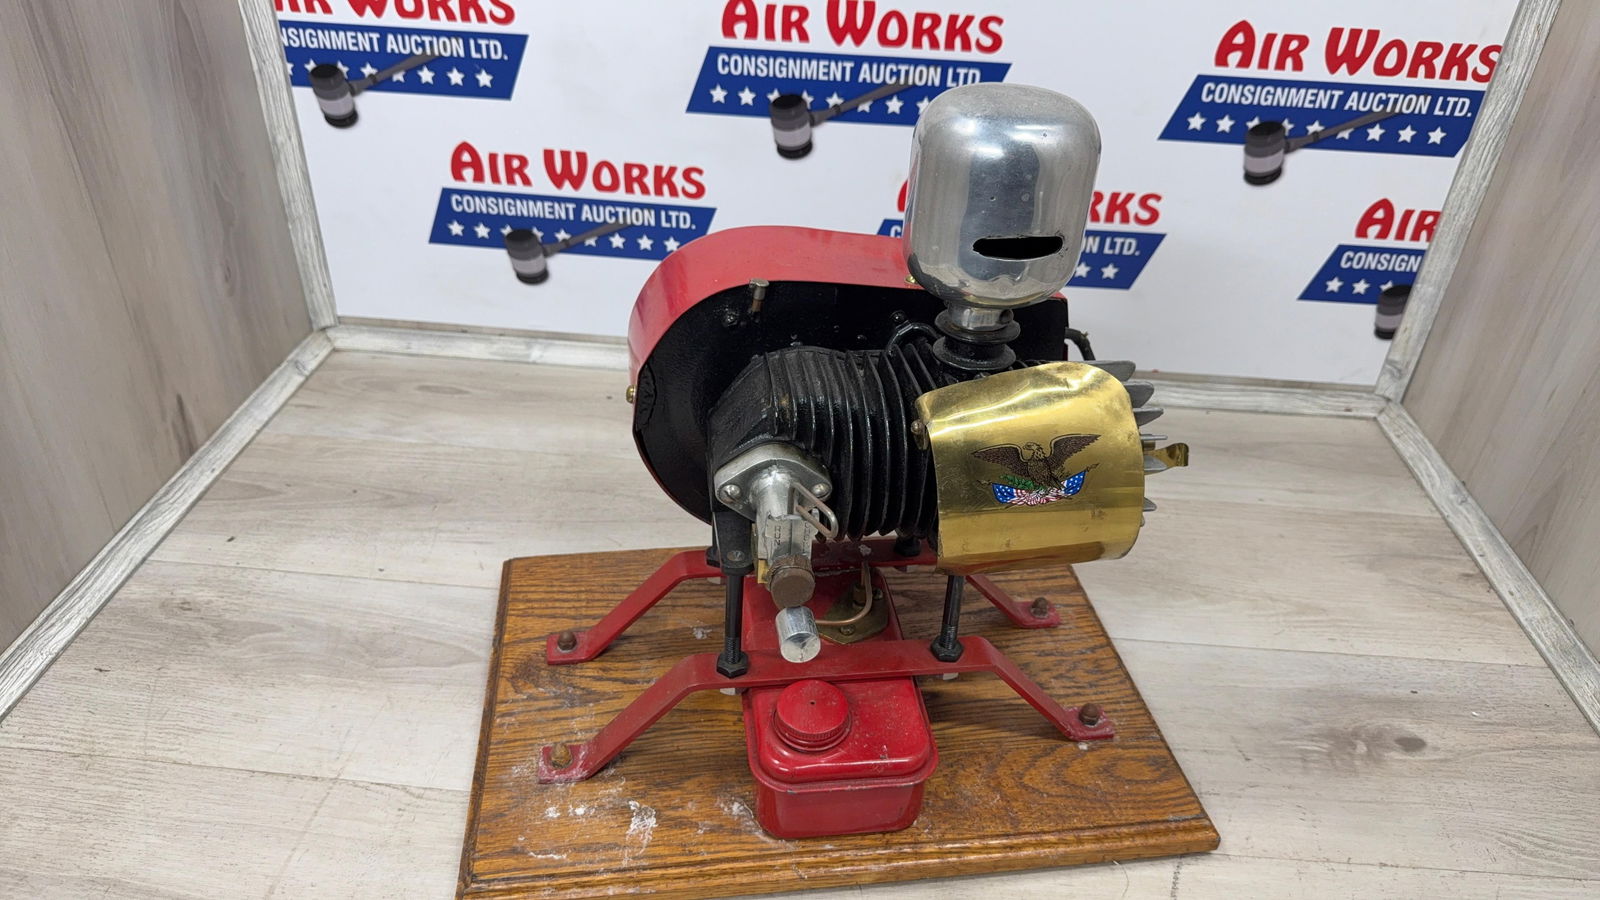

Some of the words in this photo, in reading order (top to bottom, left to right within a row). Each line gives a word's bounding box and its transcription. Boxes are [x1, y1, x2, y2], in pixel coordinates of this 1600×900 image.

[281, 27, 380, 52] NSIGNMENT
[386, 34, 464, 57] AUCTION
[469, 39, 508, 60] LTD.
[721, 0, 810, 43] AIR
[826, 0, 1004, 54] WORKS
[1214, 20, 1310, 72] AIR
[1325, 27, 1503, 83] WORKS
[717, 54, 854, 82] CONSIGNMENT
[858, 62, 942, 87] AUCTION
[946, 67, 981, 88] LTD
[1201, 82, 1344, 110] CONSIGNMENT
[1344, 91, 1431, 115] AUCTION
[1434, 96, 1472, 117] LTD.
[450, 141, 532, 187] AIR
[543, 148, 706, 200] WORKS
[452, 194, 577, 221] CONSIGNMENT
[581, 204, 656, 227] AUCTION
[660, 210, 696, 230] LTD.
[1089, 191, 1162, 227] RKS
[1355, 198, 1441, 242] AIR
[1103, 236, 1140, 256] LTD.
[1340, 251, 1422, 272] CONSIGN
